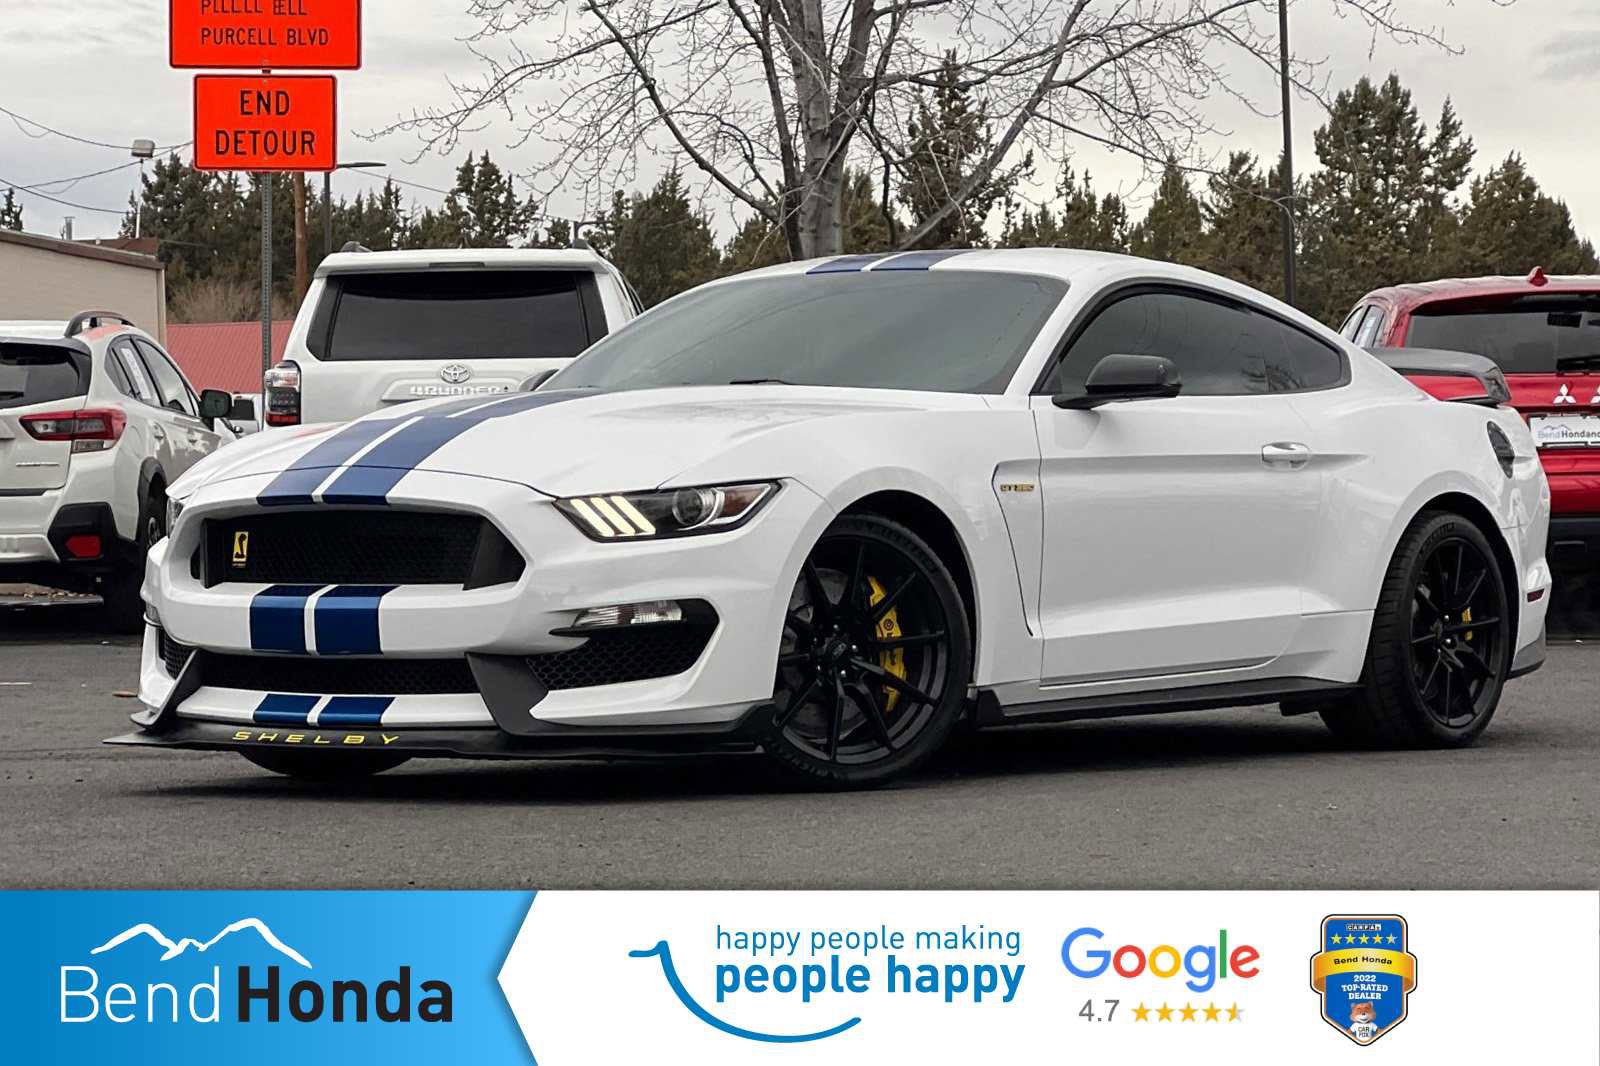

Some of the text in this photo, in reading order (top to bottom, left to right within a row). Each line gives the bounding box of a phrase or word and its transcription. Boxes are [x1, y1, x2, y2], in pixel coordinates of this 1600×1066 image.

[201, 28, 328, 46] PURCELL BLVD
[240, 90, 290, 116] END
[215, 130, 316, 156] DETOUR
[232, 731, 399, 744] SHELBY
